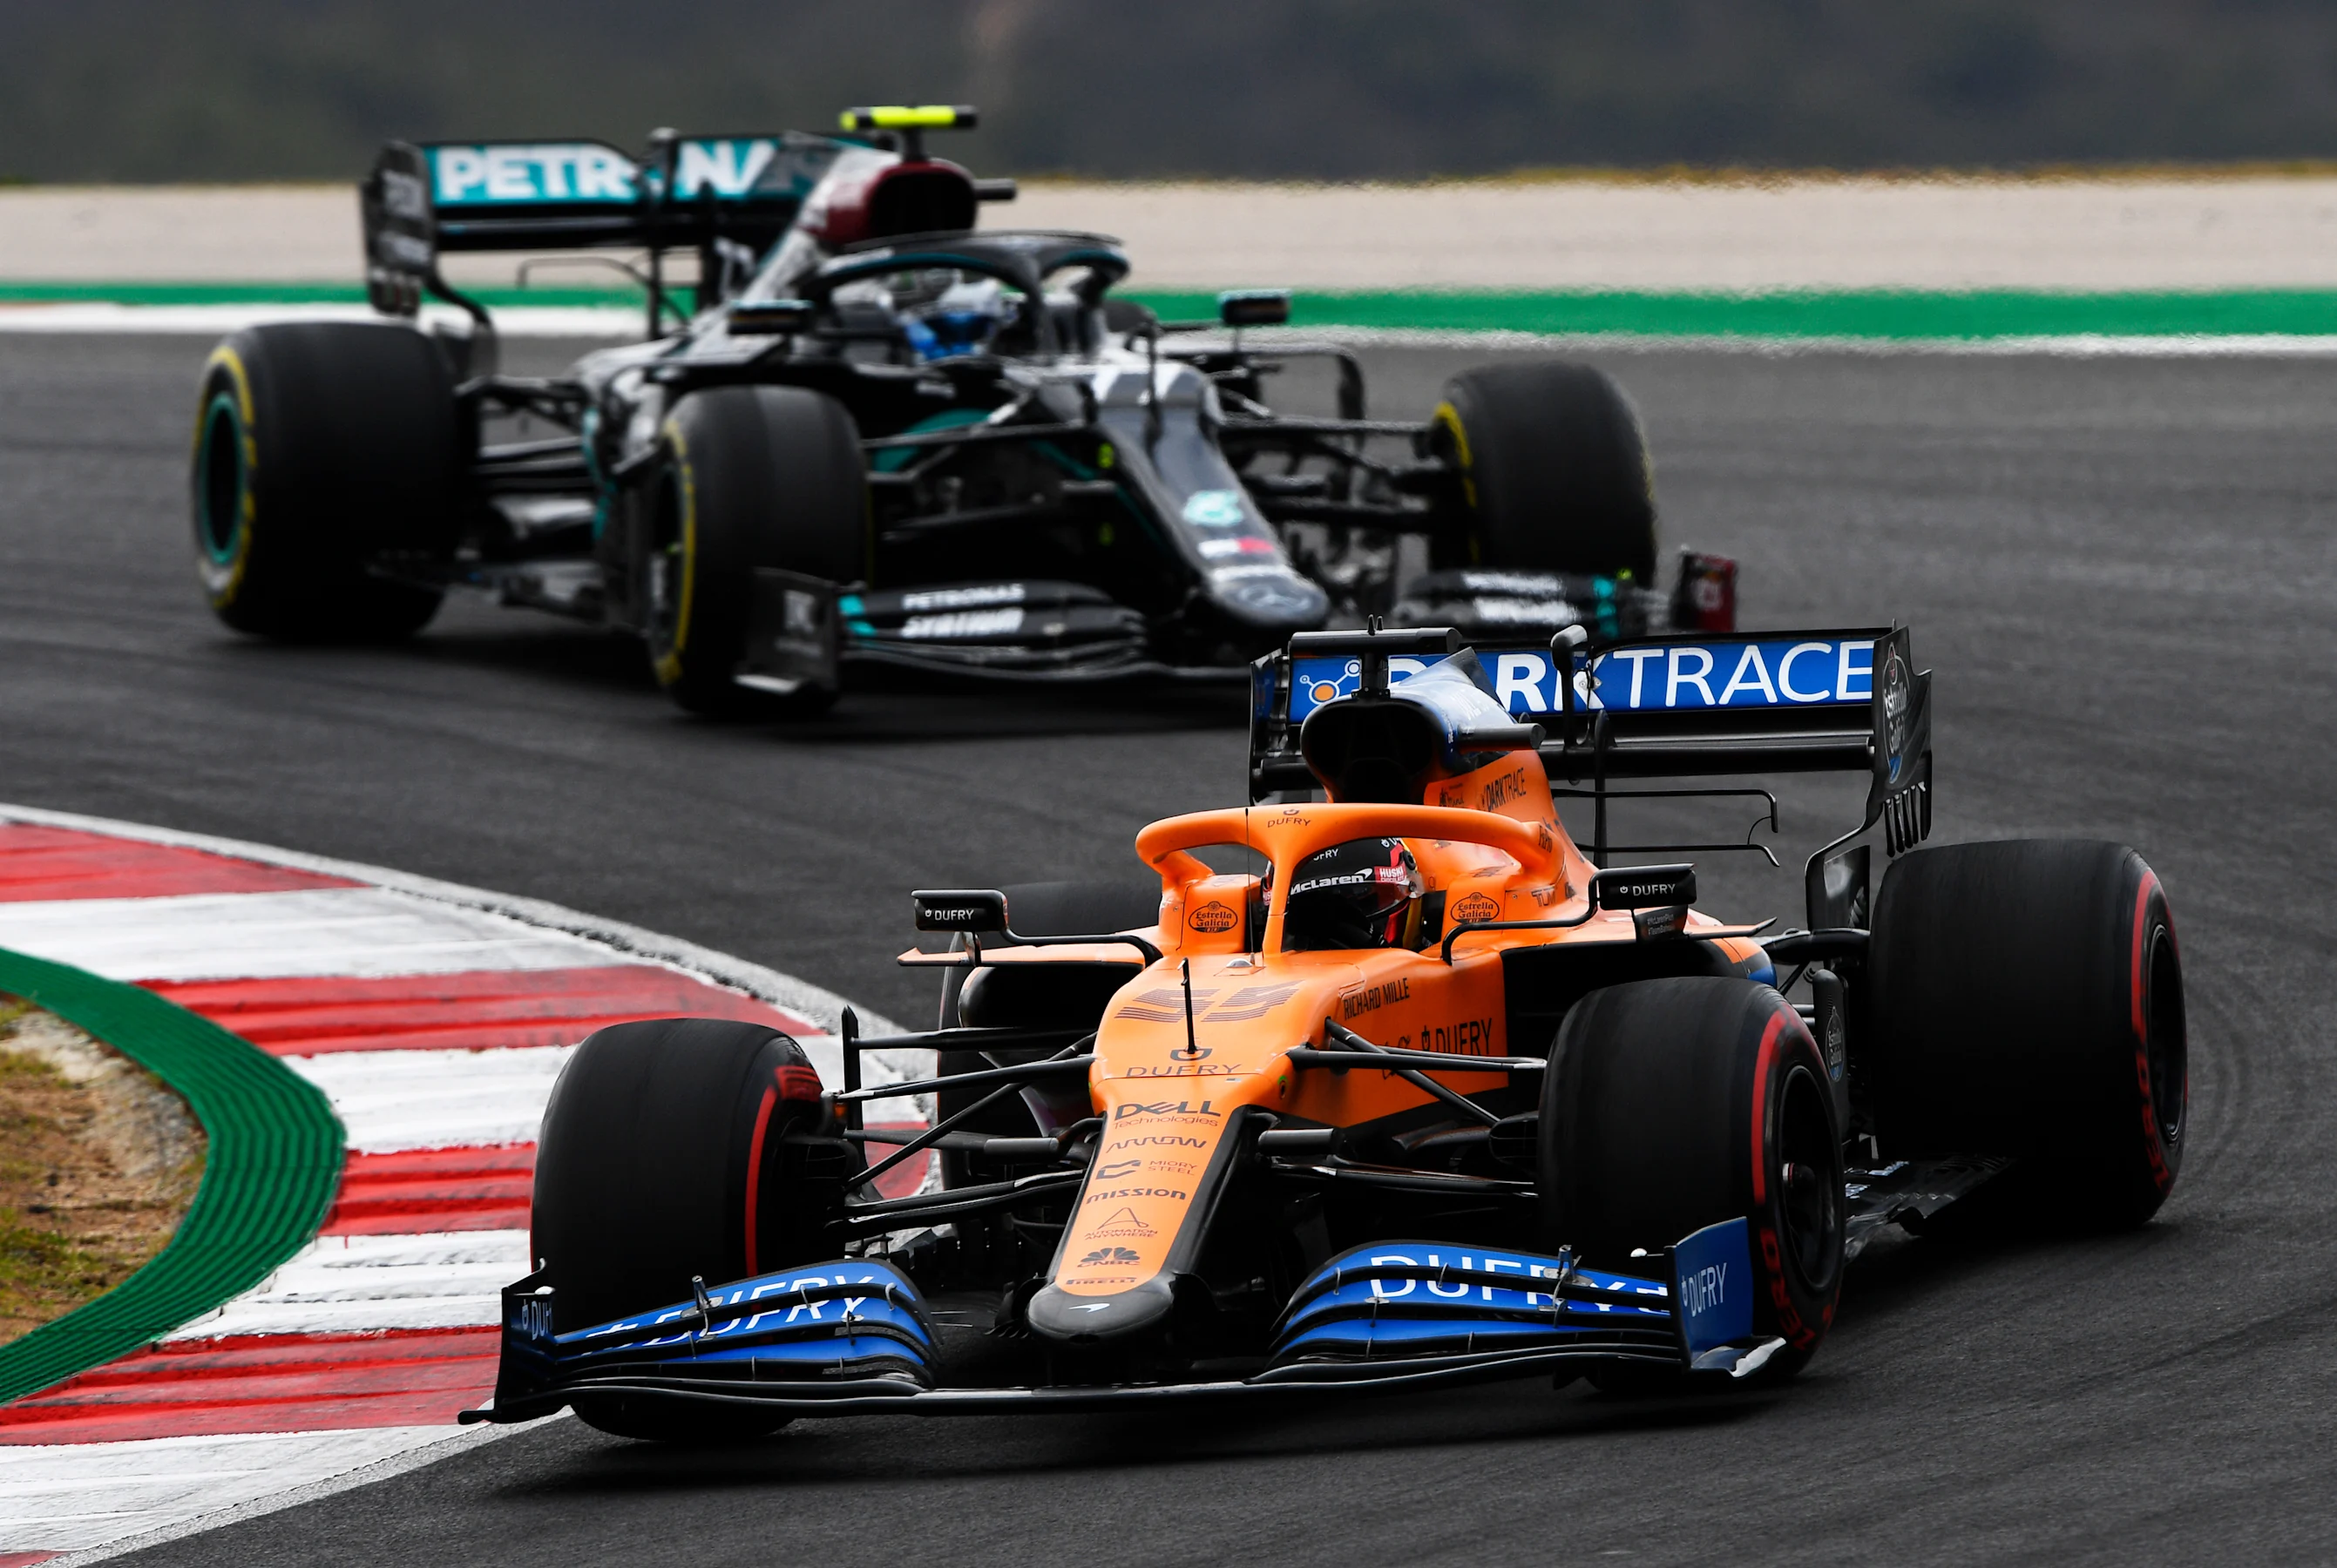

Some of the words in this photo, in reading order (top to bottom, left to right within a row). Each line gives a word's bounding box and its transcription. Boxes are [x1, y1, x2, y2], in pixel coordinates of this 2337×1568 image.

[1386, 640, 1874, 713] DRKTRACE
[1485, 767, 1527, 812] DARKTRACE
[1267, 817, 1311, 828] DUFRY
[1379, 867, 1404, 878] HUSKI
[1633, 883, 1676, 896] DUFRY
[1457, 902, 1494, 912] Estrella
[935, 909, 974, 921] DUFRY
[1458, 909, 1491, 919] Galicia
[1196, 918, 1229, 928] Galicia
[1344, 986, 1380, 1020] RICHARD
[1382, 977, 1410, 1005] MILLE
[1126, 1064, 1243, 1078] DUFRY
[1114, 1100, 1221, 1121] DELL
[1113, 1115, 1219, 1130] Technologies
[1148, 1166, 1195, 1175] STEEL
[1149, 1160, 1198, 1169] MIORY
[1084, 1228, 1158, 1237] AUTOMATION
[1688, 1262, 1727, 1317] DUFRY
